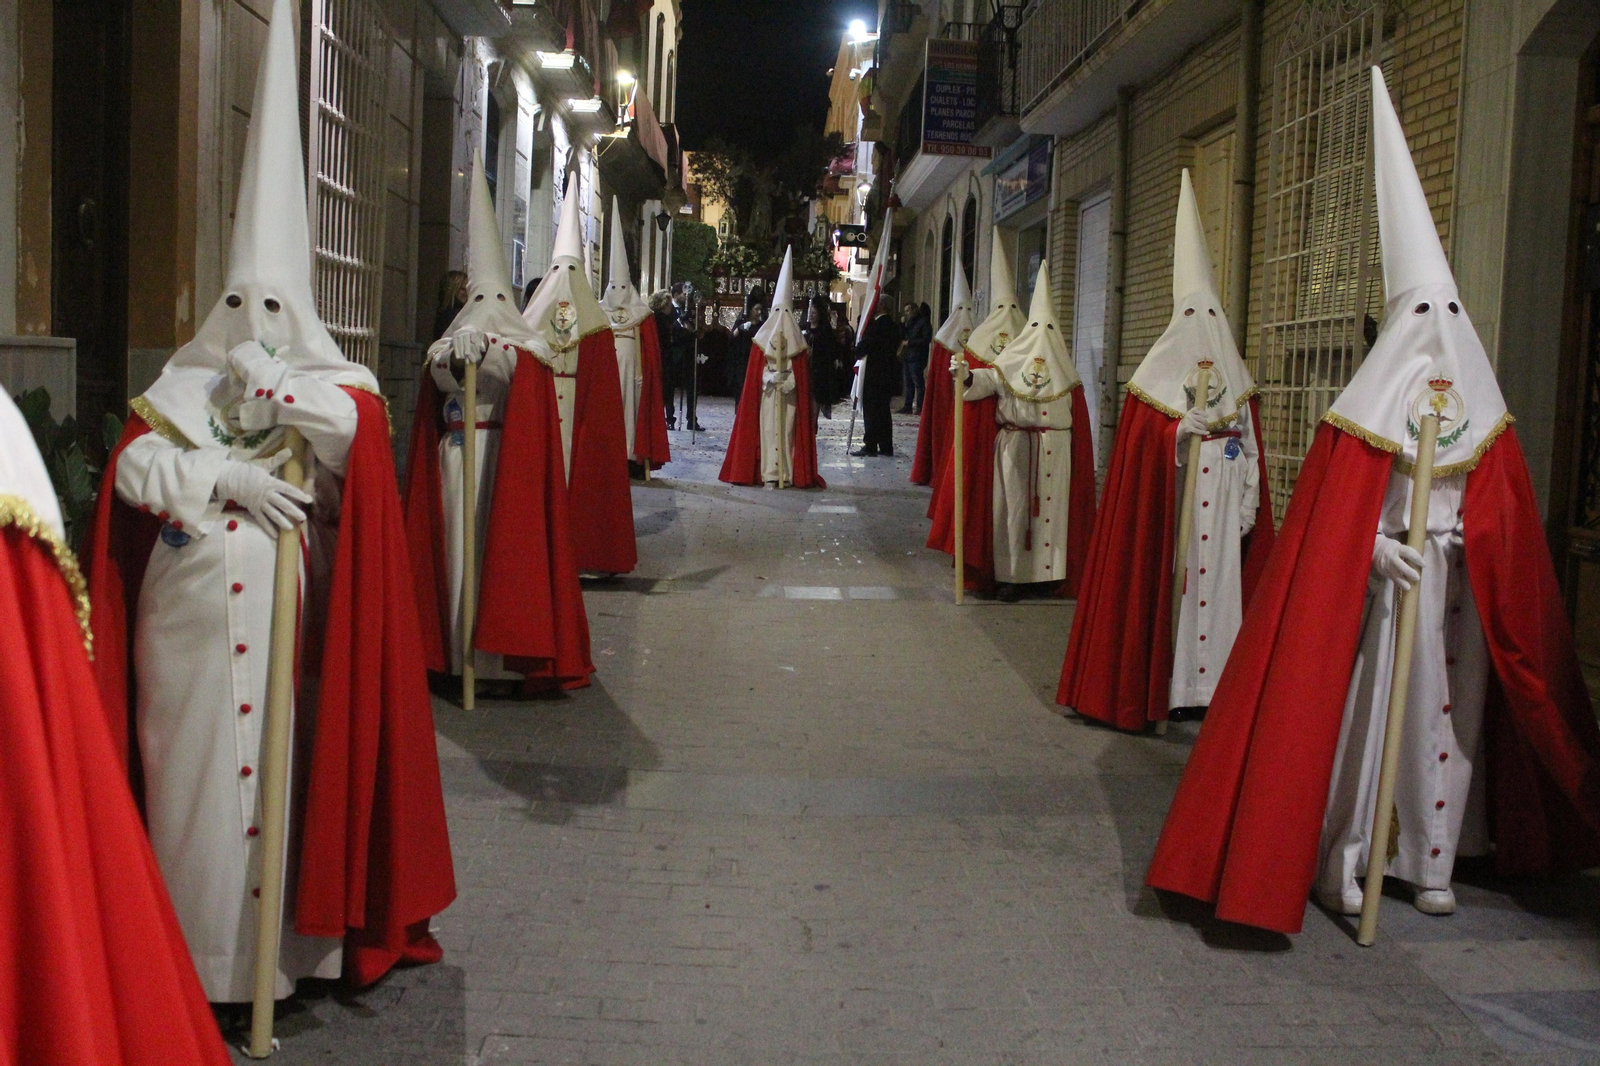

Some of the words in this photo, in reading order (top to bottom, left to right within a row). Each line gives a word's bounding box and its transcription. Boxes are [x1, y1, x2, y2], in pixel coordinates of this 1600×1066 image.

[935, 84, 961, 94] DUPLEX
[930, 96, 958, 106] CHALETS
[963, 98, 976, 107] LOC
[930, 108, 955, 117] PLANES
[942, 120, 975, 130] PARCELAS
[927, 130, 959, 141] TERRENOS
[940, 144, 954, 154] 950
[956, 146, 966, 155] 39
